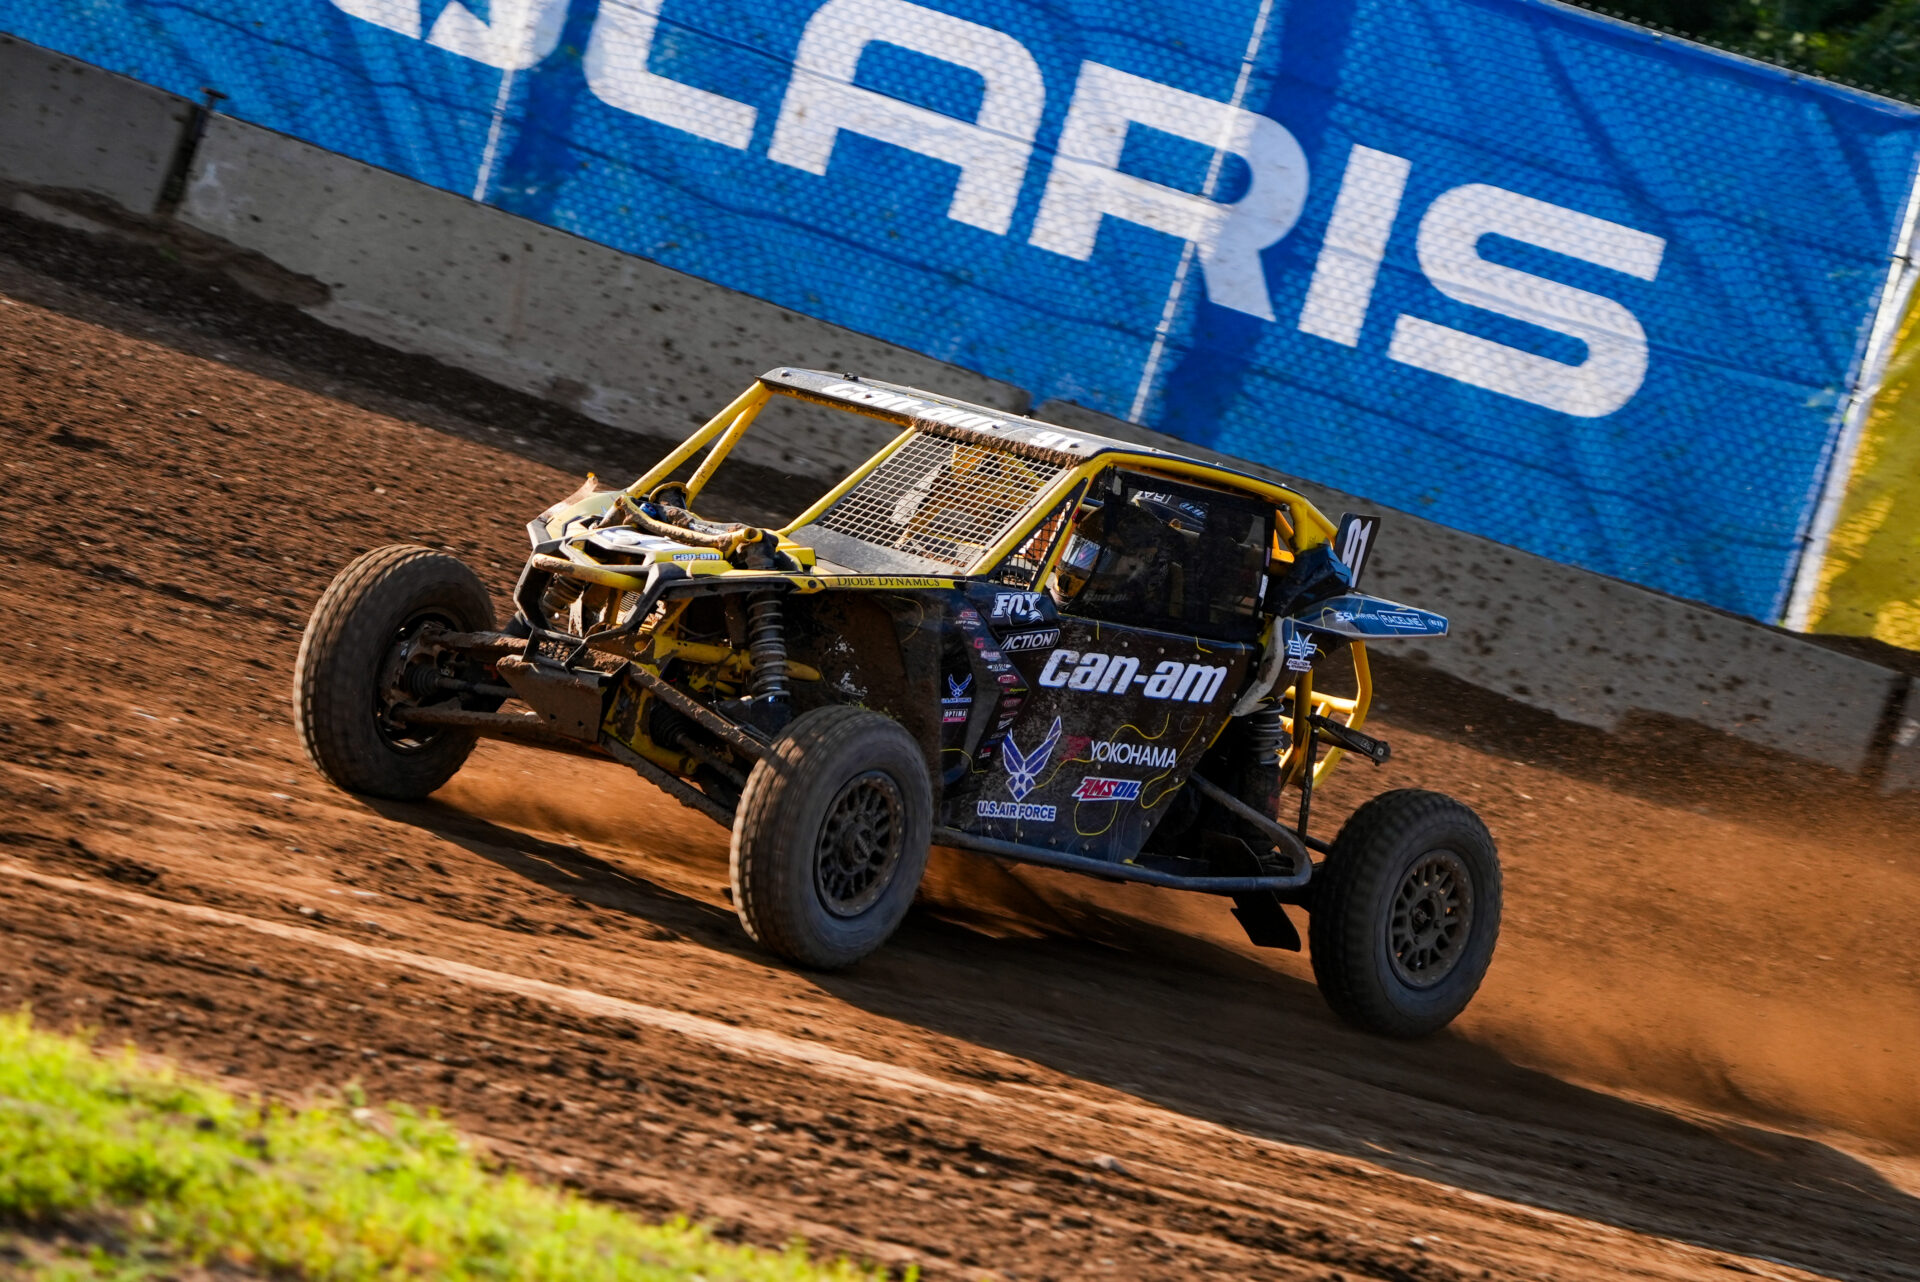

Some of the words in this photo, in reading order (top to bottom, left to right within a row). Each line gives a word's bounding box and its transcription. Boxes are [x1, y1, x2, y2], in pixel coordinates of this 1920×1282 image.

[1342, 519, 1373, 588] 91
[992, 593, 1041, 618] FOX
[1001, 633, 1054, 650] ACTION
[944, 710, 967, 718] OPTIMA
[1090, 740, 1177, 769] YOKOHAMA
[1072, 777, 1142, 801] AMSOIL
